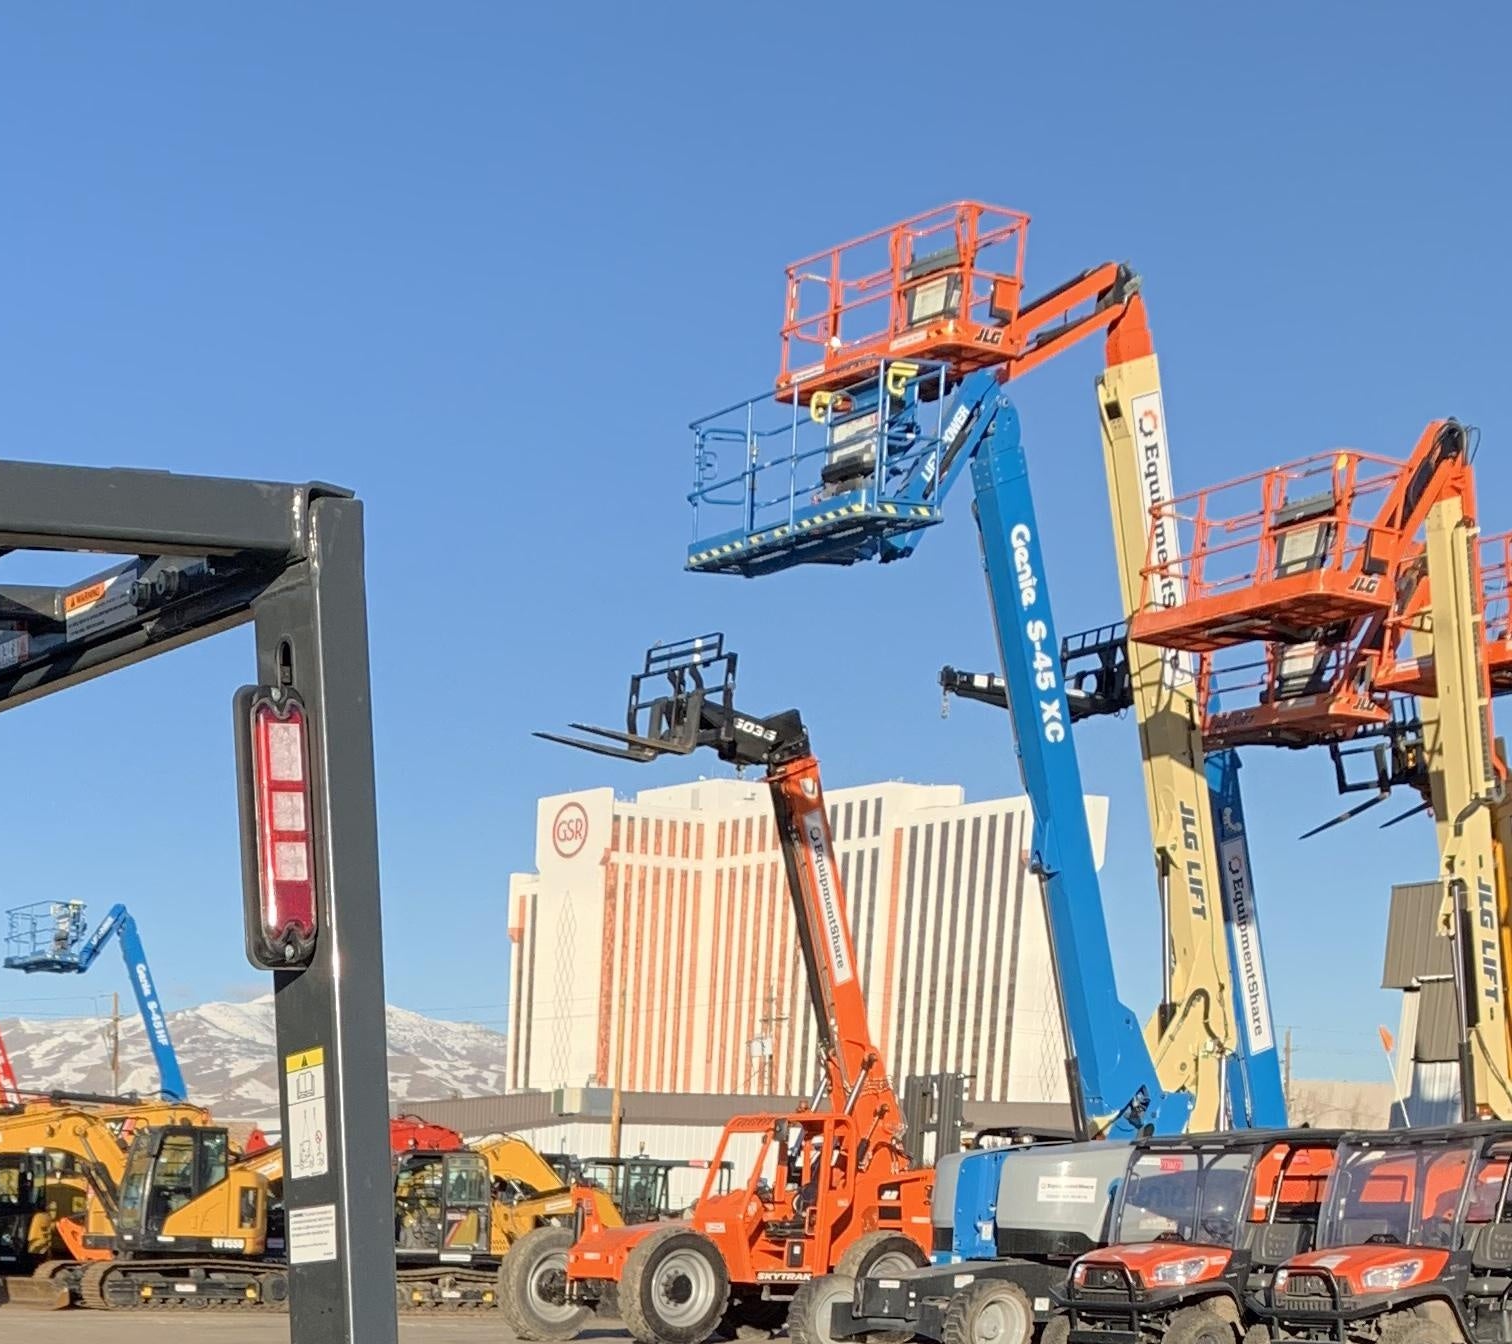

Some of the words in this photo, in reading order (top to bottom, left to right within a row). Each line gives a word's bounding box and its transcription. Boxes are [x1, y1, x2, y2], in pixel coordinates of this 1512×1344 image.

[974, 327, 1002, 345] JLG
[1010, 523, 1038, 611] Genie
[1348, 577, 1378, 594] JLG
[1026, 619, 1057, 692] S-45
[1040, 698, 1065, 744] XC
[1353, 698, 1375, 712] JLG
[557, 817, 584, 842] GSR
[1180, 800, 1199, 851] JLG
[814, 843, 844, 969] EquipmentShare
[1186, 860, 1207, 920] LIFT
[1477, 877, 1494, 930] JLG
[136, 963, 151, 997] Genie
[1232, 879, 1263, 1037] EquipmentShare
[1482, 944, 1499, 1002] LIFT
[757, 1272, 812, 1281] SKYTRAK
